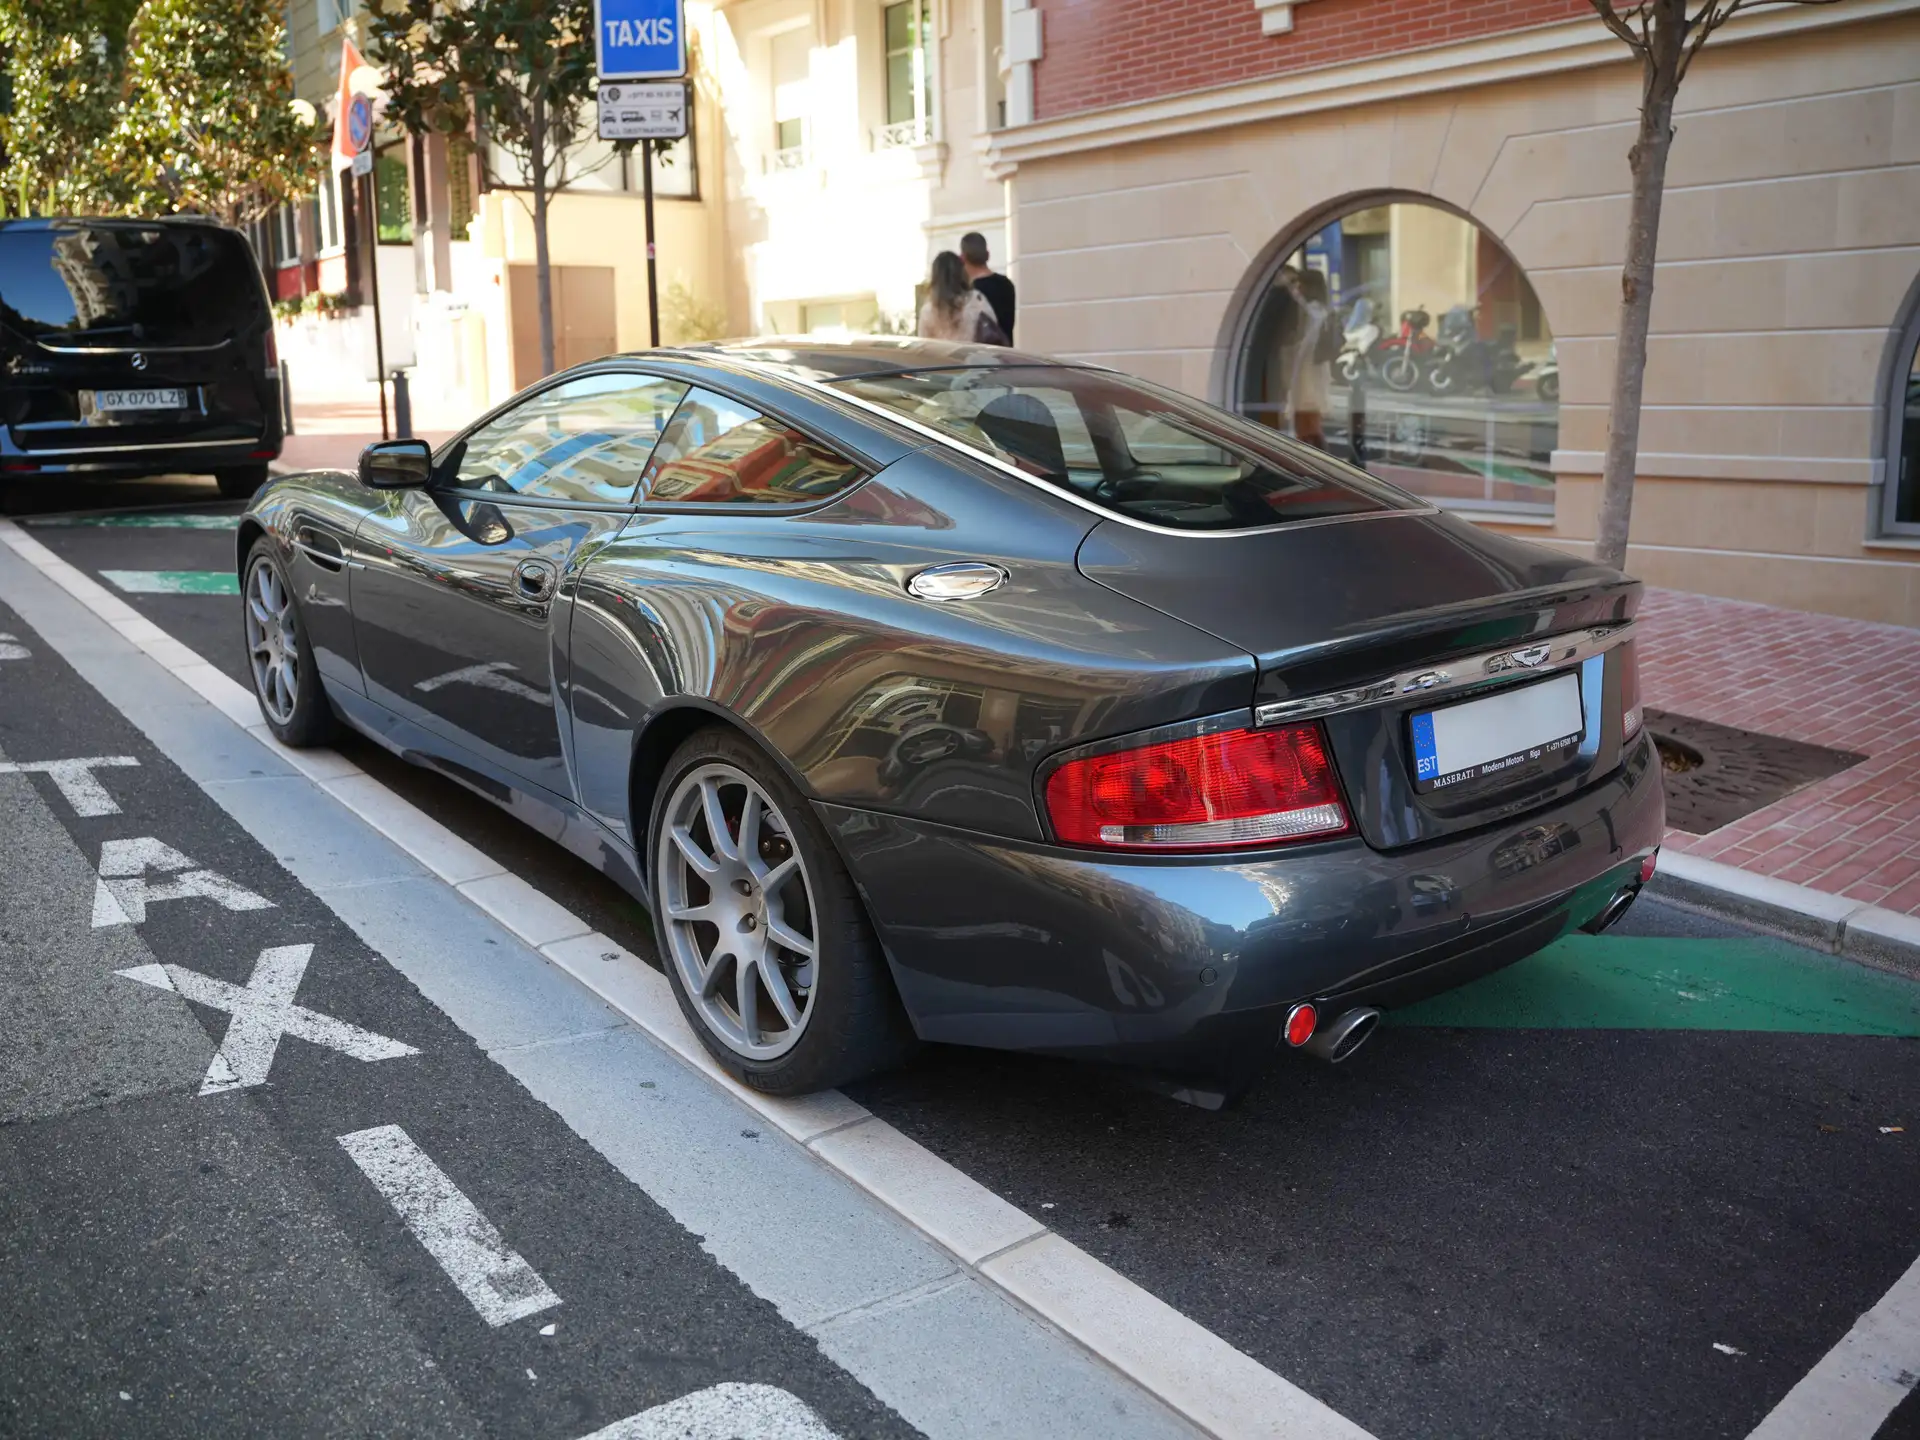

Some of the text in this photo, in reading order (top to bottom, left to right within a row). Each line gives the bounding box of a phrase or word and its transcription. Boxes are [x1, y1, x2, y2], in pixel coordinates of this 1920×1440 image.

[604, 17, 674, 48] TAXIS
[1417, 755, 1436, 774] EST
[1481, 761, 1505, 774] Modena
[1505, 754, 1525, 767] Motors
[1529, 749, 1541, 760] Riga
[1433, 769, 1475, 789] MASERATI
[0, 755, 843, 1440] TAXI
